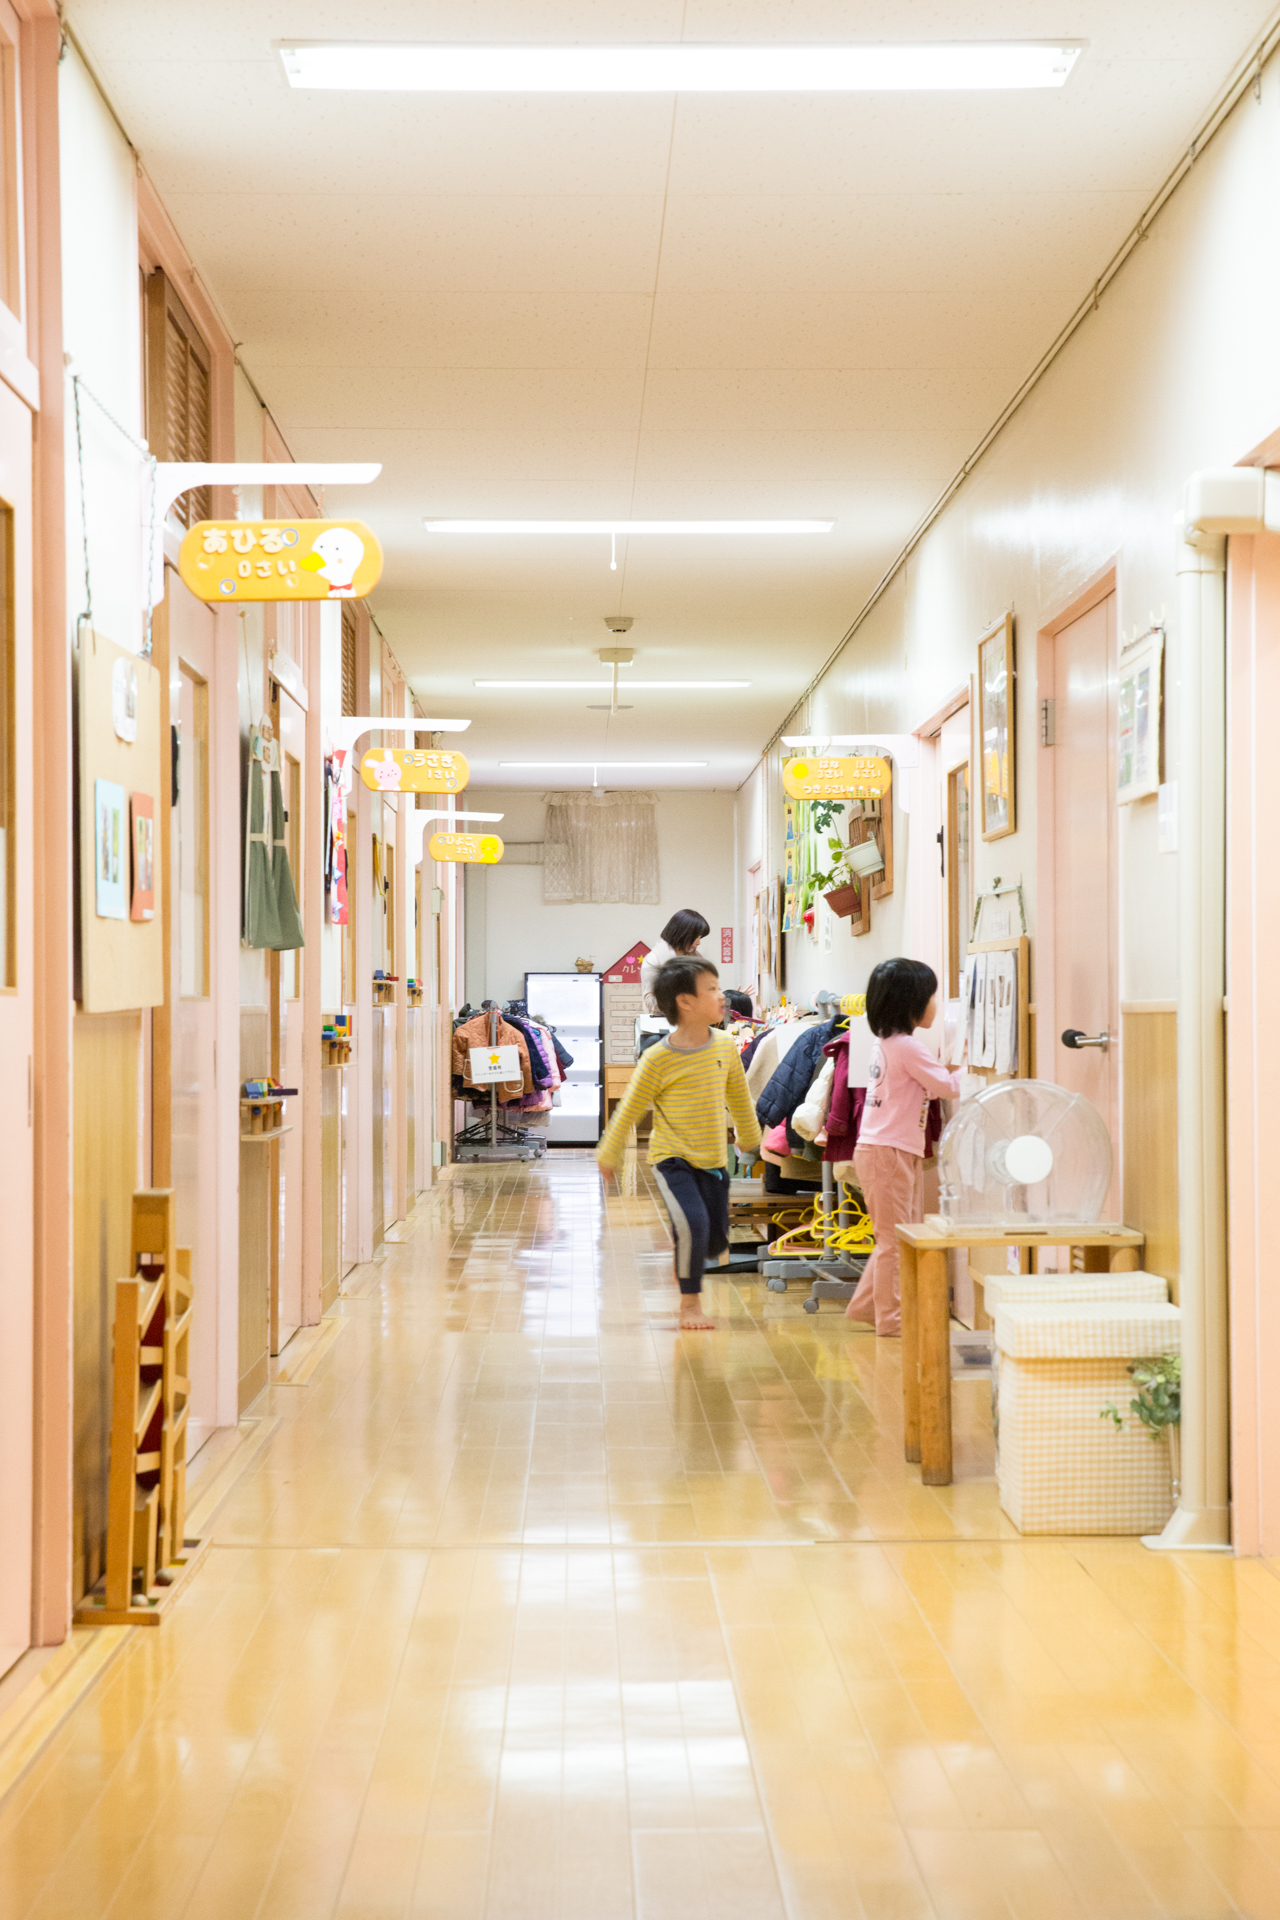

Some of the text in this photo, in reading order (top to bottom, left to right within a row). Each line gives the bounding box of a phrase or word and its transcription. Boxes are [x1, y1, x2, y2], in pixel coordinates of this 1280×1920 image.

[203, 528, 285, 554] あひる
[238, 560, 297, 578] 0さい
[413, 753, 456, 768] うさぎ
[819, 760, 875, 769] はな ほし
[818, 769, 881, 779] 3さい 4さい
[803, 784, 850, 794] つき 5さい
[445, 836, 474, 847] ひよこ
[723, 928, 732, 956] 消火器
